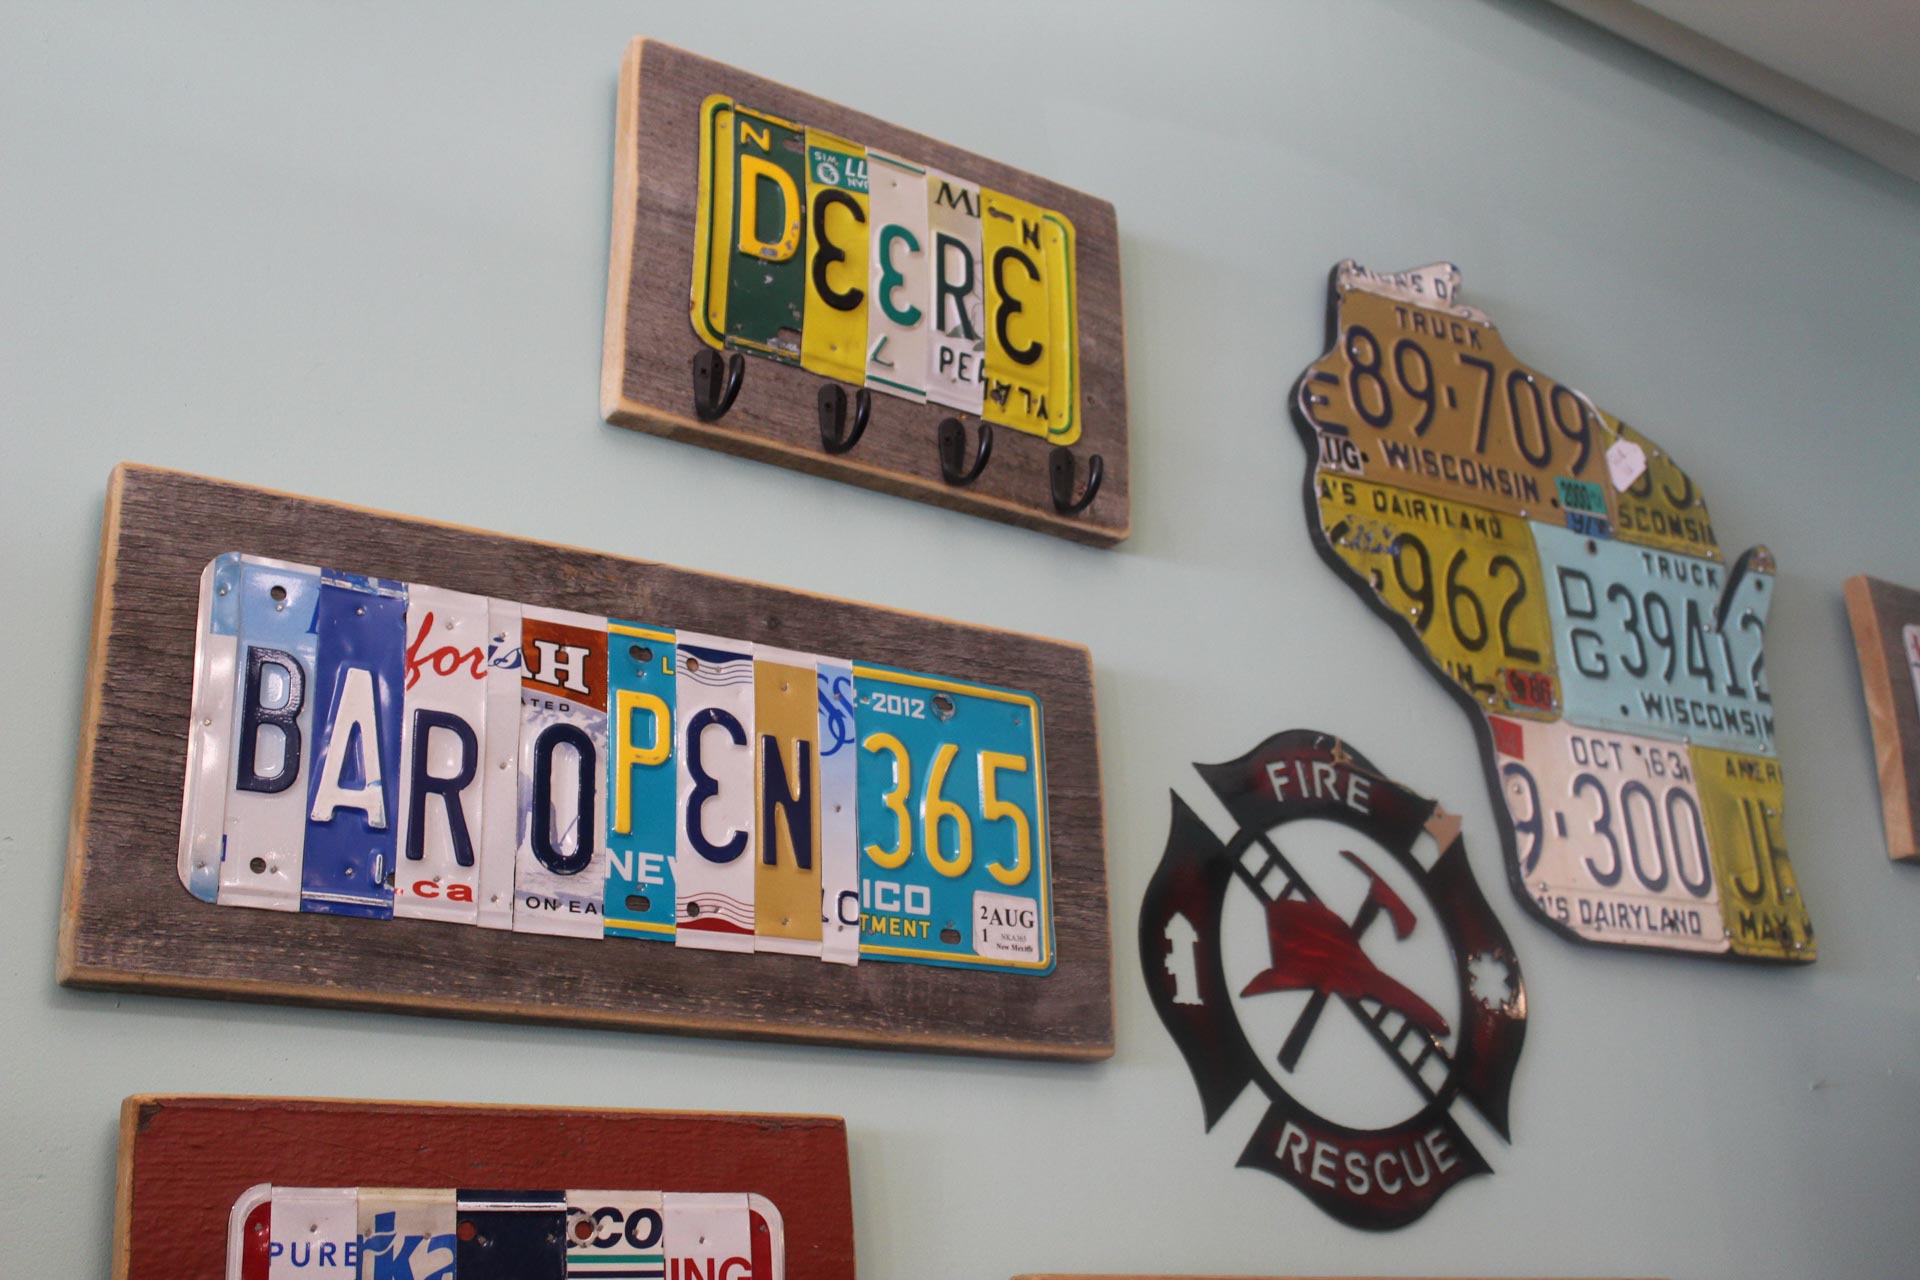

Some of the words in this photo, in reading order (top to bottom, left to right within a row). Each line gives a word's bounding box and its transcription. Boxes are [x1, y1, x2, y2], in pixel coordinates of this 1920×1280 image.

[738, 152, 1044, 366] DEERE
[1395, 306, 1483, 350] TRUCK
[1381, 439, 1540, 503] WISCONSIN
[1372, 489, 1503, 539] DAIRYLAND
[1642, 552, 1721, 590] TRUCK
[853, 689, 926, 720] -2012
[1641, 691, 1775, 738] WISCONSIN
[236, 645, 480, 867] BAR
[530, 688, 812, 876] OPEN
[863, 732, 1031, 886] 365
[1570, 735, 1622, 771] OCT
[1265, 761, 1372, 815] FIRE
[525, 896, 558, 911] ON
[569, 899, 604, 916] EA
[989, 907, 1035, 929] AUG
[1579, 898, 1702, 936] DAIRYLAND
[996, 943, 1010, 951] New
[1275, 1121, 1459, 1196] RESCUE
[270, 1241, 357, 1268] PURE
